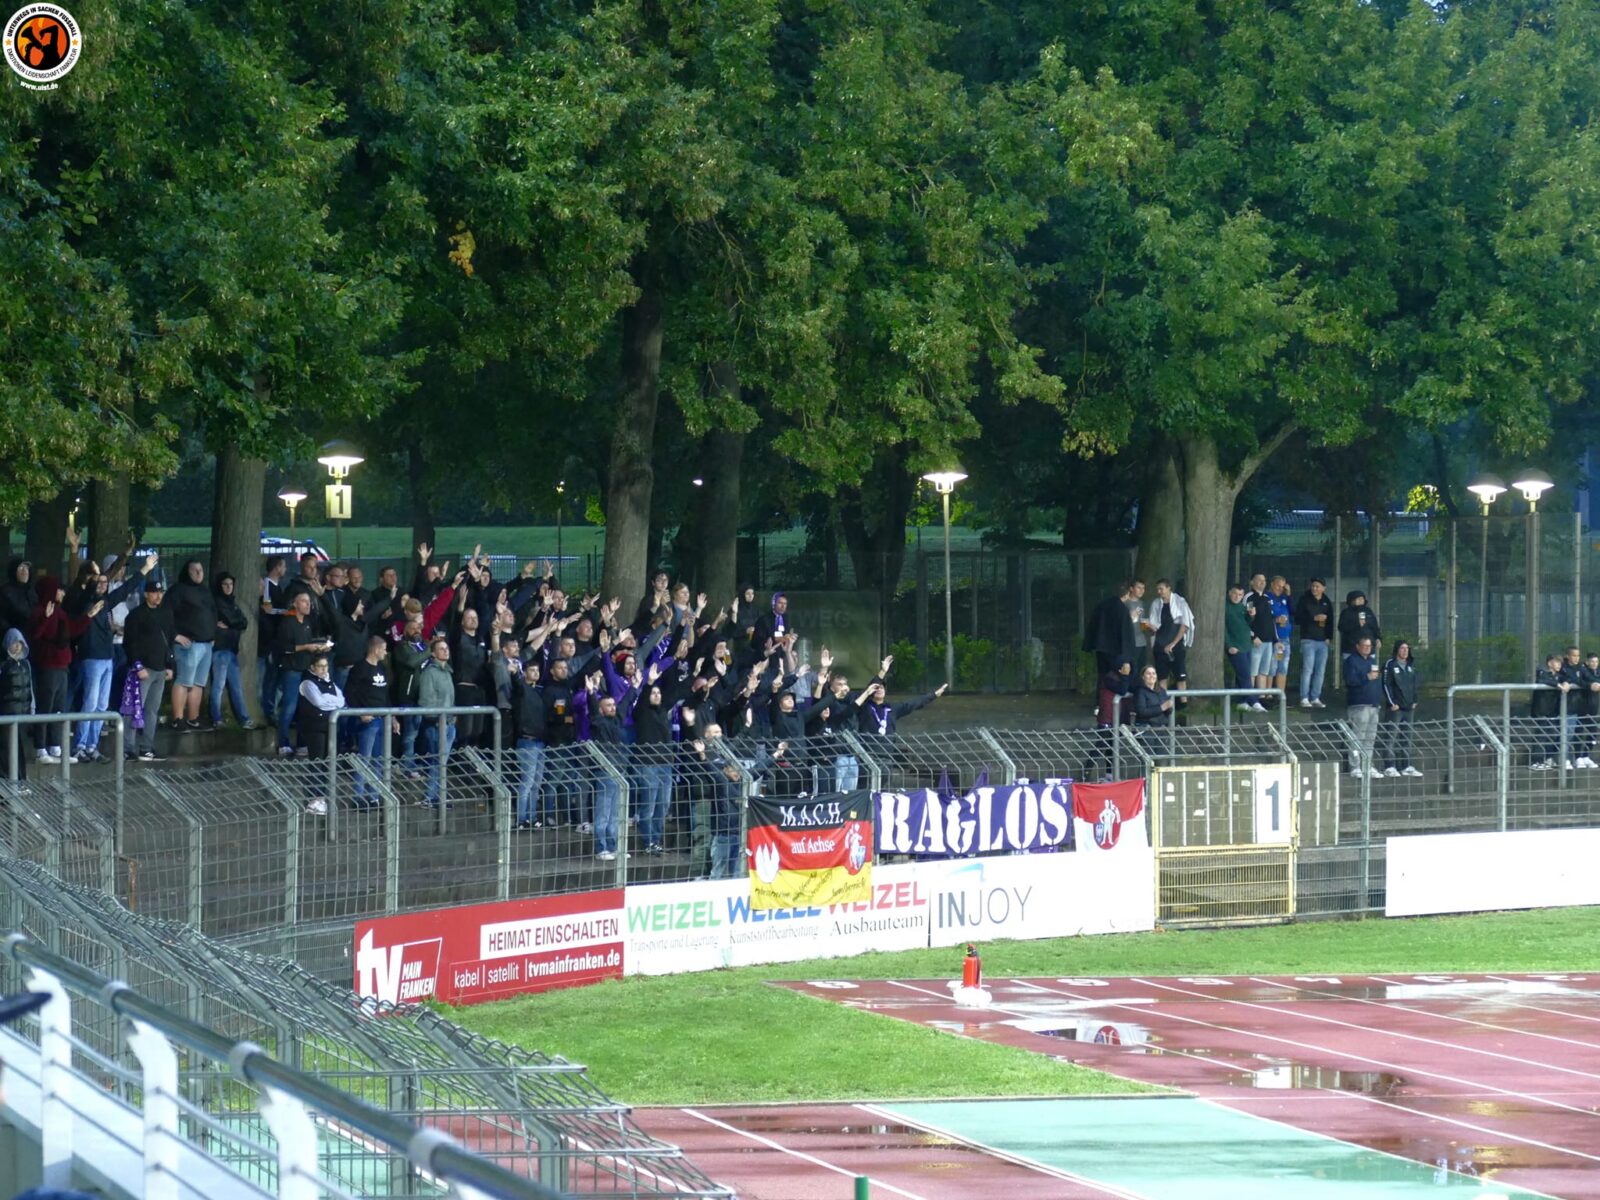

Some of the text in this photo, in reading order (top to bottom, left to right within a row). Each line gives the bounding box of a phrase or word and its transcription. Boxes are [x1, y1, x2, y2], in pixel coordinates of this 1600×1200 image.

[336, 489, 344, 514] 1
[780, 802, 844, 826] M.A.C.H.
[880, 785, 1068, 853] RAGLOS
[1265, 780, 1279, 831] 1
[791, 836, 836, 854] auf Achse
[627, 901, 722, 933] WEIZEL
[938, 886, 1032, 928] INJOY
[489, 918, 619, 952] HEIMAT EINSCHALTEN
[830, 914, 924, 936] Ausbauteam
[402, 960, 422, 980] MAIN
[454, 949, 621, 989] kabel satellit tvmainfranken.de
[400, 977, 434, 1000] FRANKEN
